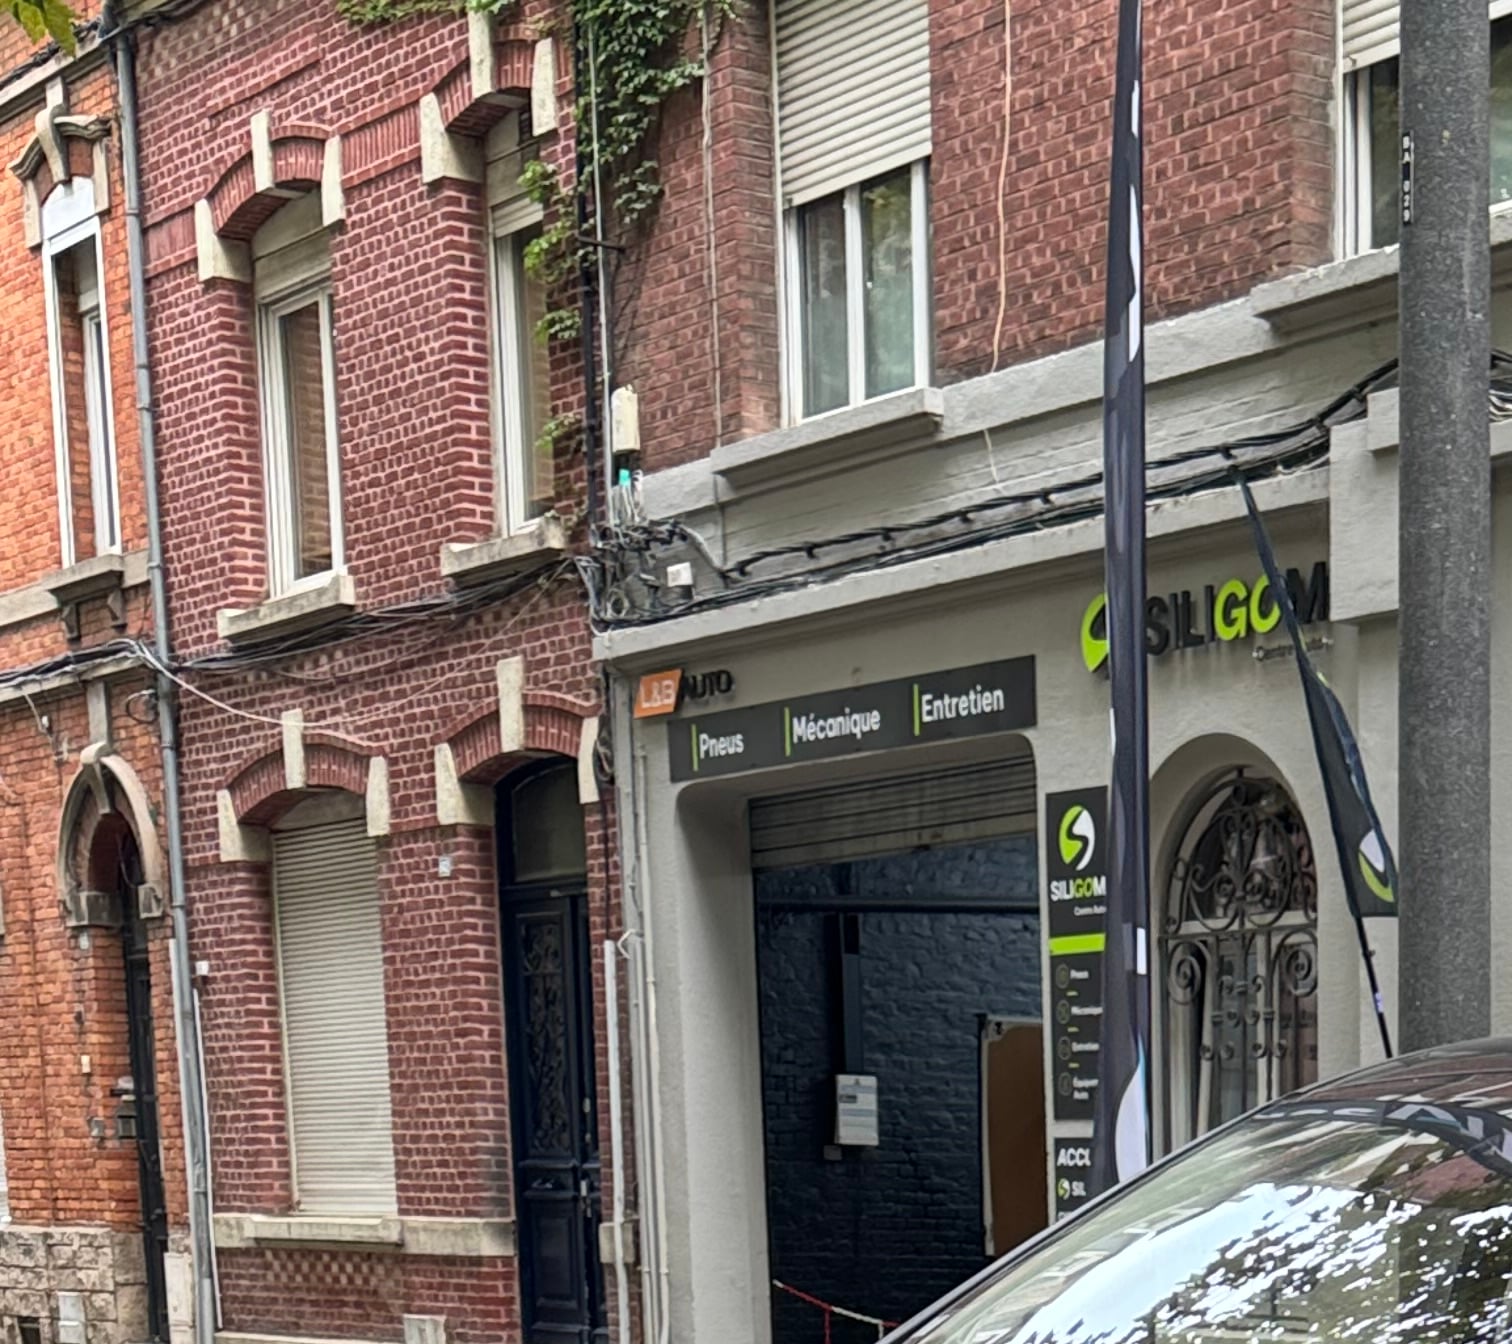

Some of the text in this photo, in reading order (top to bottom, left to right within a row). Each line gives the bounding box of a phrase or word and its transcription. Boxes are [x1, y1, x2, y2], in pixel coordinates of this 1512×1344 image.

[699, 683, 1005, 760] Pneus Mécanique Entretien
[1050, 874, 1107, 902] SILIGOM
